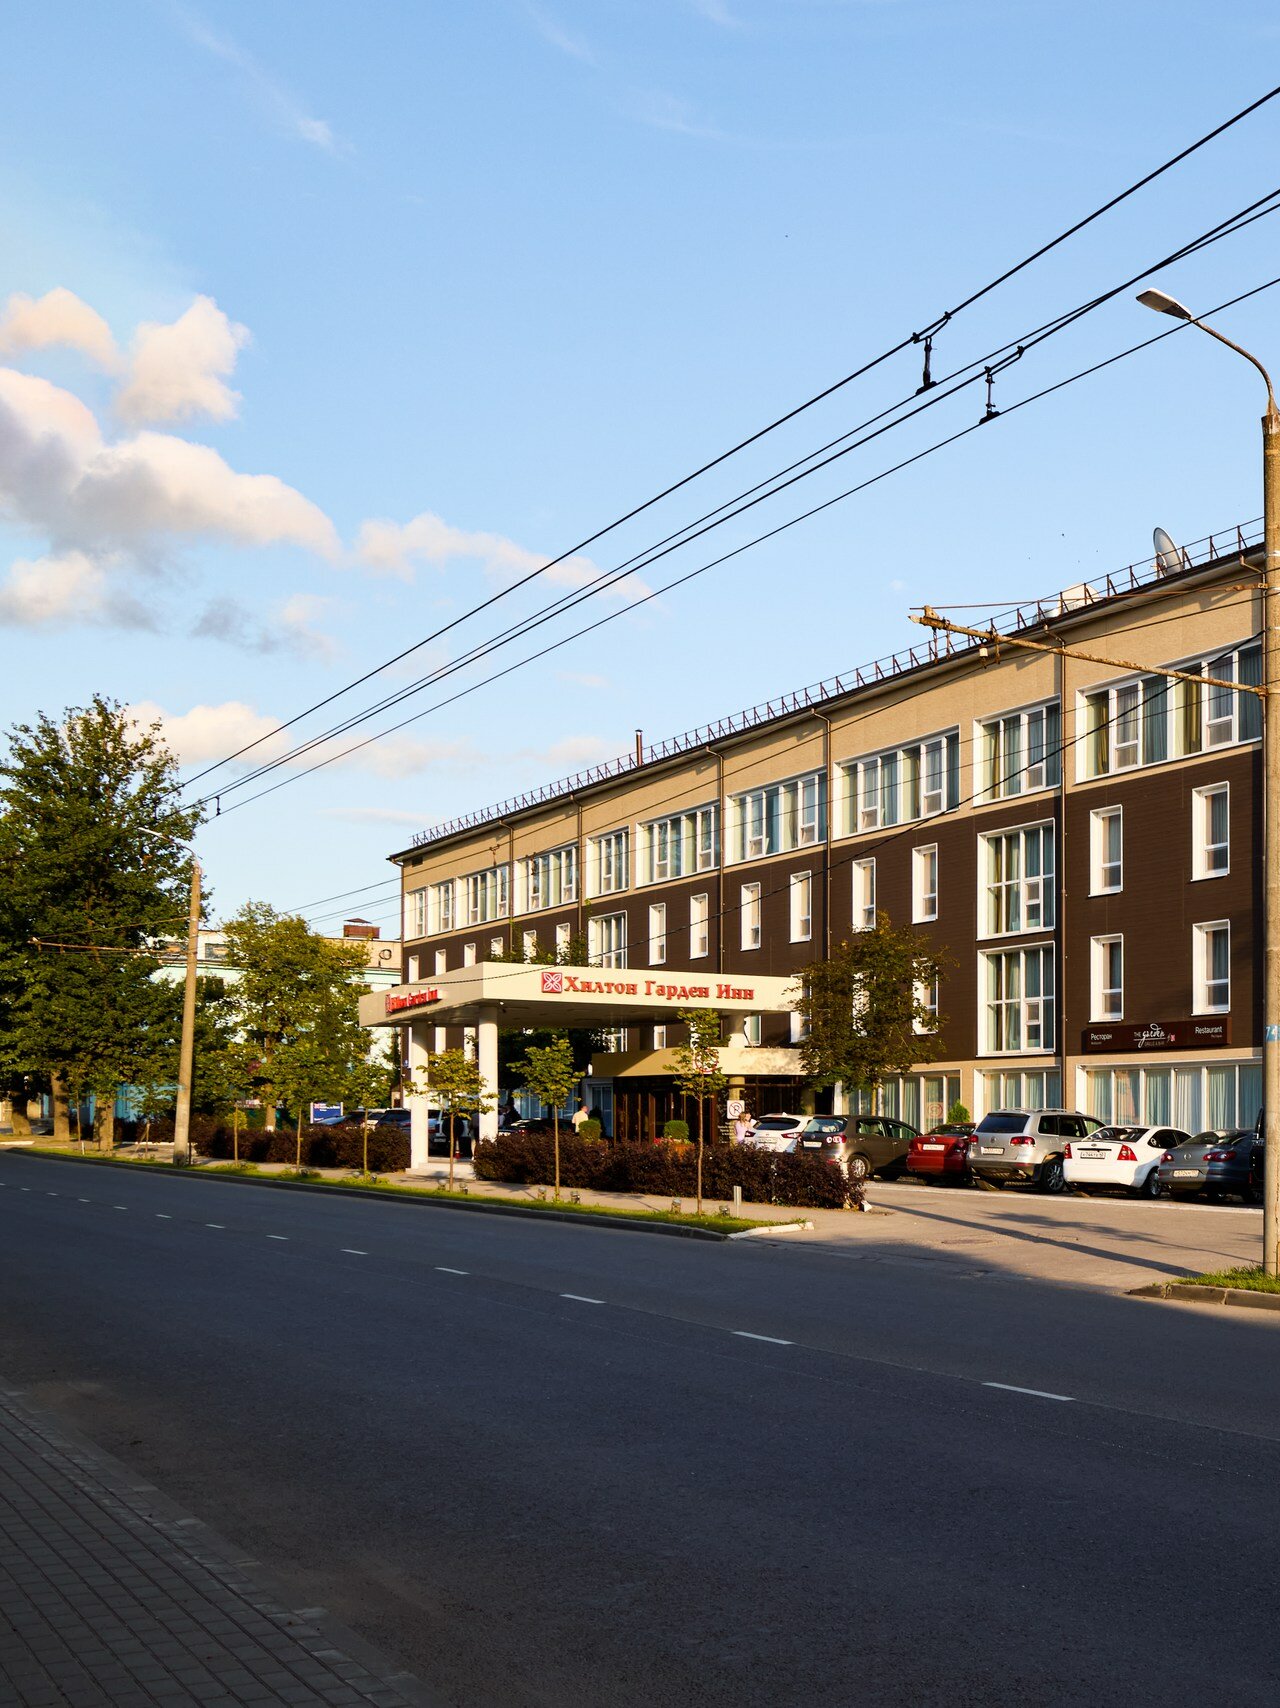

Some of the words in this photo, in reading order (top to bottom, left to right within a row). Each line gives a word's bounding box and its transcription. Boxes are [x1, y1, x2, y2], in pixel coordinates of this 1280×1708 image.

[564, 976, 638, 995] Хилтон
[645, 980, 710, 1001] Гарден
[716, 983, 755, 1001] Инн
[1195, 1026, 1223, 1035] Restaurant
[1091, 1033, 1113, 1041] Ресторан
